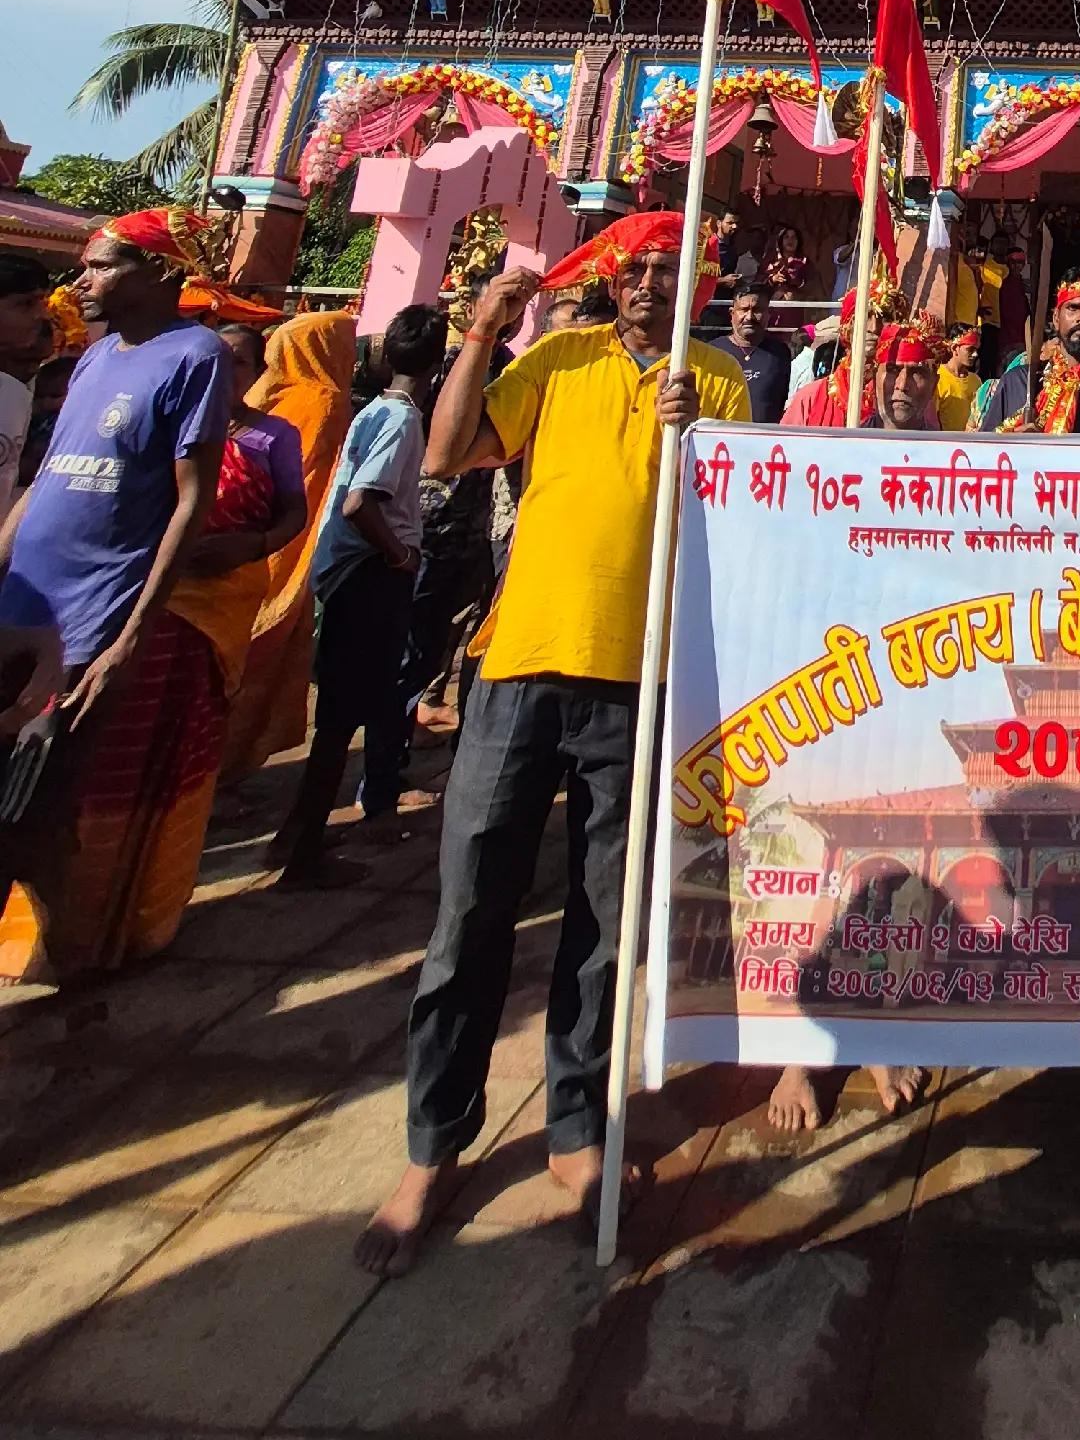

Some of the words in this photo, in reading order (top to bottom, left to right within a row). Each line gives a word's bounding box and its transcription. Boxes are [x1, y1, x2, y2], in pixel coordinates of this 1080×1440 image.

[692, 442, 735, 511] श्री
[749, 444, 791, 513] श्री
[806, 463, 863, 517] १०८
[880, 454, 1018, 519] कंकालिनी
[848, 526, 955, 557] हनुमाननगर
[964, 523, 1055, 554] कंकालिनी
[672, 624, 883, 837] फूलपाती
[745, 867, 822, 899] स्थान
[745, 920, 816, 948] समय
[931, 924, 949, 951] २
[959, 916, 1004, 952] बजे
[1012, 915, 1071, 954] देखि
[739, 957, 804, 995] मिति
[828, 967, 994, 1003] २०८२/०६/१३
